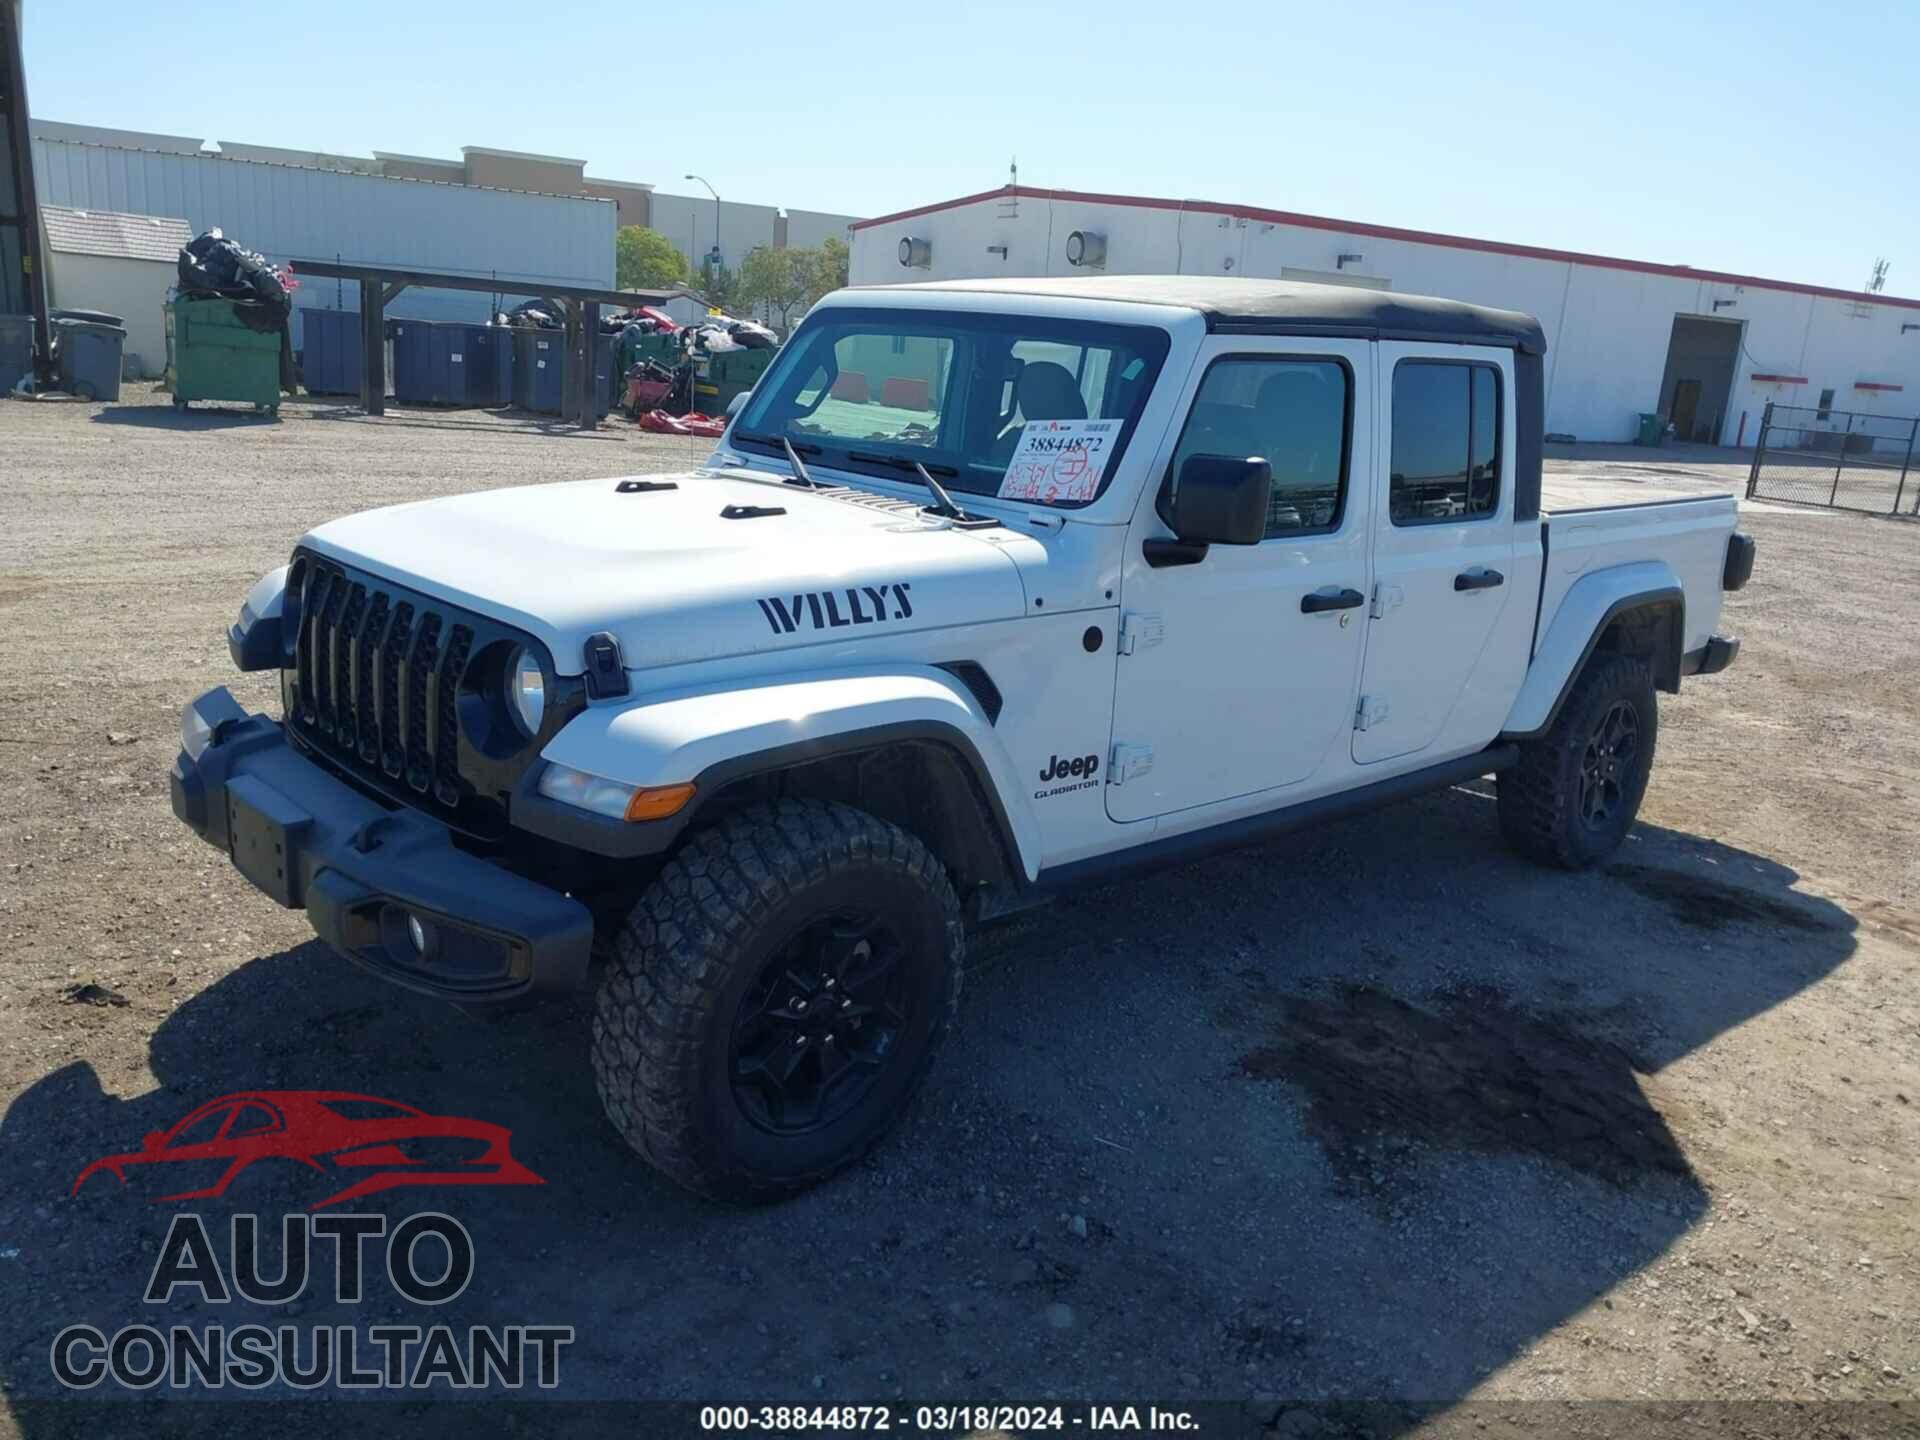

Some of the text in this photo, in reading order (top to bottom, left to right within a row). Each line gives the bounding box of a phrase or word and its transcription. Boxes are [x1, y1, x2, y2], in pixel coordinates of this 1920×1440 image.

[1024, 437, 1104, 452] 38844872
[756, 582, 913, 634] WILLYS
[1040, 755, 1099, 782] Jeep
[1034, 779, 1099, 799] GLADIATOR
